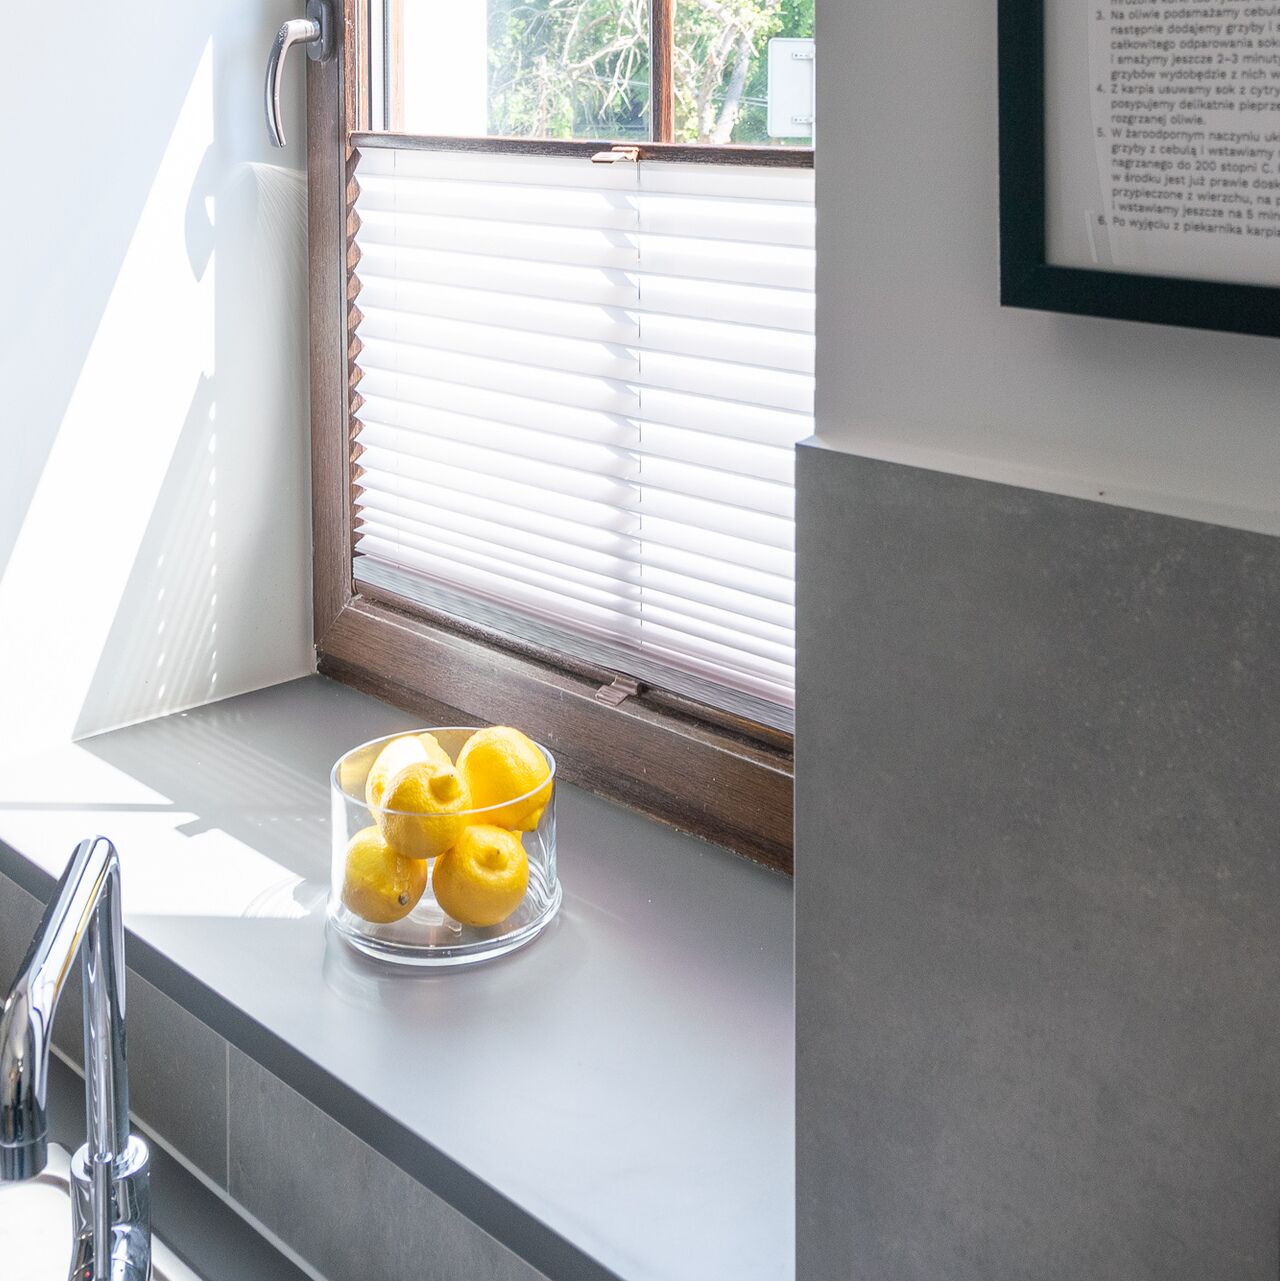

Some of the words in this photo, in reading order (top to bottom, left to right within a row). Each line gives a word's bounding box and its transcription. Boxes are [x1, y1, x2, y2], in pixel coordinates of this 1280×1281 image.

[1095, 9, 1105, 19] 3.
[1109, 9, 1125, 19] Na
[1127, 7, 1161, 19] oliwie
[1162, 5, 1240, 20] podsmażamy
[1109, 23, 1164, 36] następnie
[1165, 21, 1223, 35] dodajemy
[1224, 20, 1265, 34] grzyby
[1109, 37, 1176, 51] całkowitego
[1178, 36, 1254, 50] odparowania
[1110, 112, 1167, 126] rozgrzanej
[1110, 141, 1146, 156] grzyby
[1148, 145, 1156, 153] z
[1158, 143, 1197, 157] cebulą
[1206, 145, 1274, 160] wstawiamy
[1110, 158, 1174, 172] nagrzanego
[1175, 158, 1192, 170] do
[1194, 160, 1217, 171] 200
[1219, 161, 1257, 175] stopni
[1260, 162, 1273, 173] C.
[1110, 173, 1121, 182] w
[1123, 171, 1162, 184] środku
[1163, 174, 1186, 187] jest
[1187, 174, 1206, 188] już
[1208, 176, 1249, 190] prawie
[1111, 186, 1183, 202] przypieczone
[1186, 191, 1193, 200] z
[1255, 195, 1272, 204] na
[1117, 201, 1179, 217] wstawiamy
[1181, 205, 1224, 220] jeszcze
[1227, 209, 1243, 218] na
[1245, 208, 1254, 219] 5
[1096, 215, 1107, 225] 6.
[1111, 215, 1126, 226] Po
[1128, 216, 1170, 232] wyjęciu
[1172, 221, 1179, 230] z
[1182, 219, 1243, 236] piekarnika
